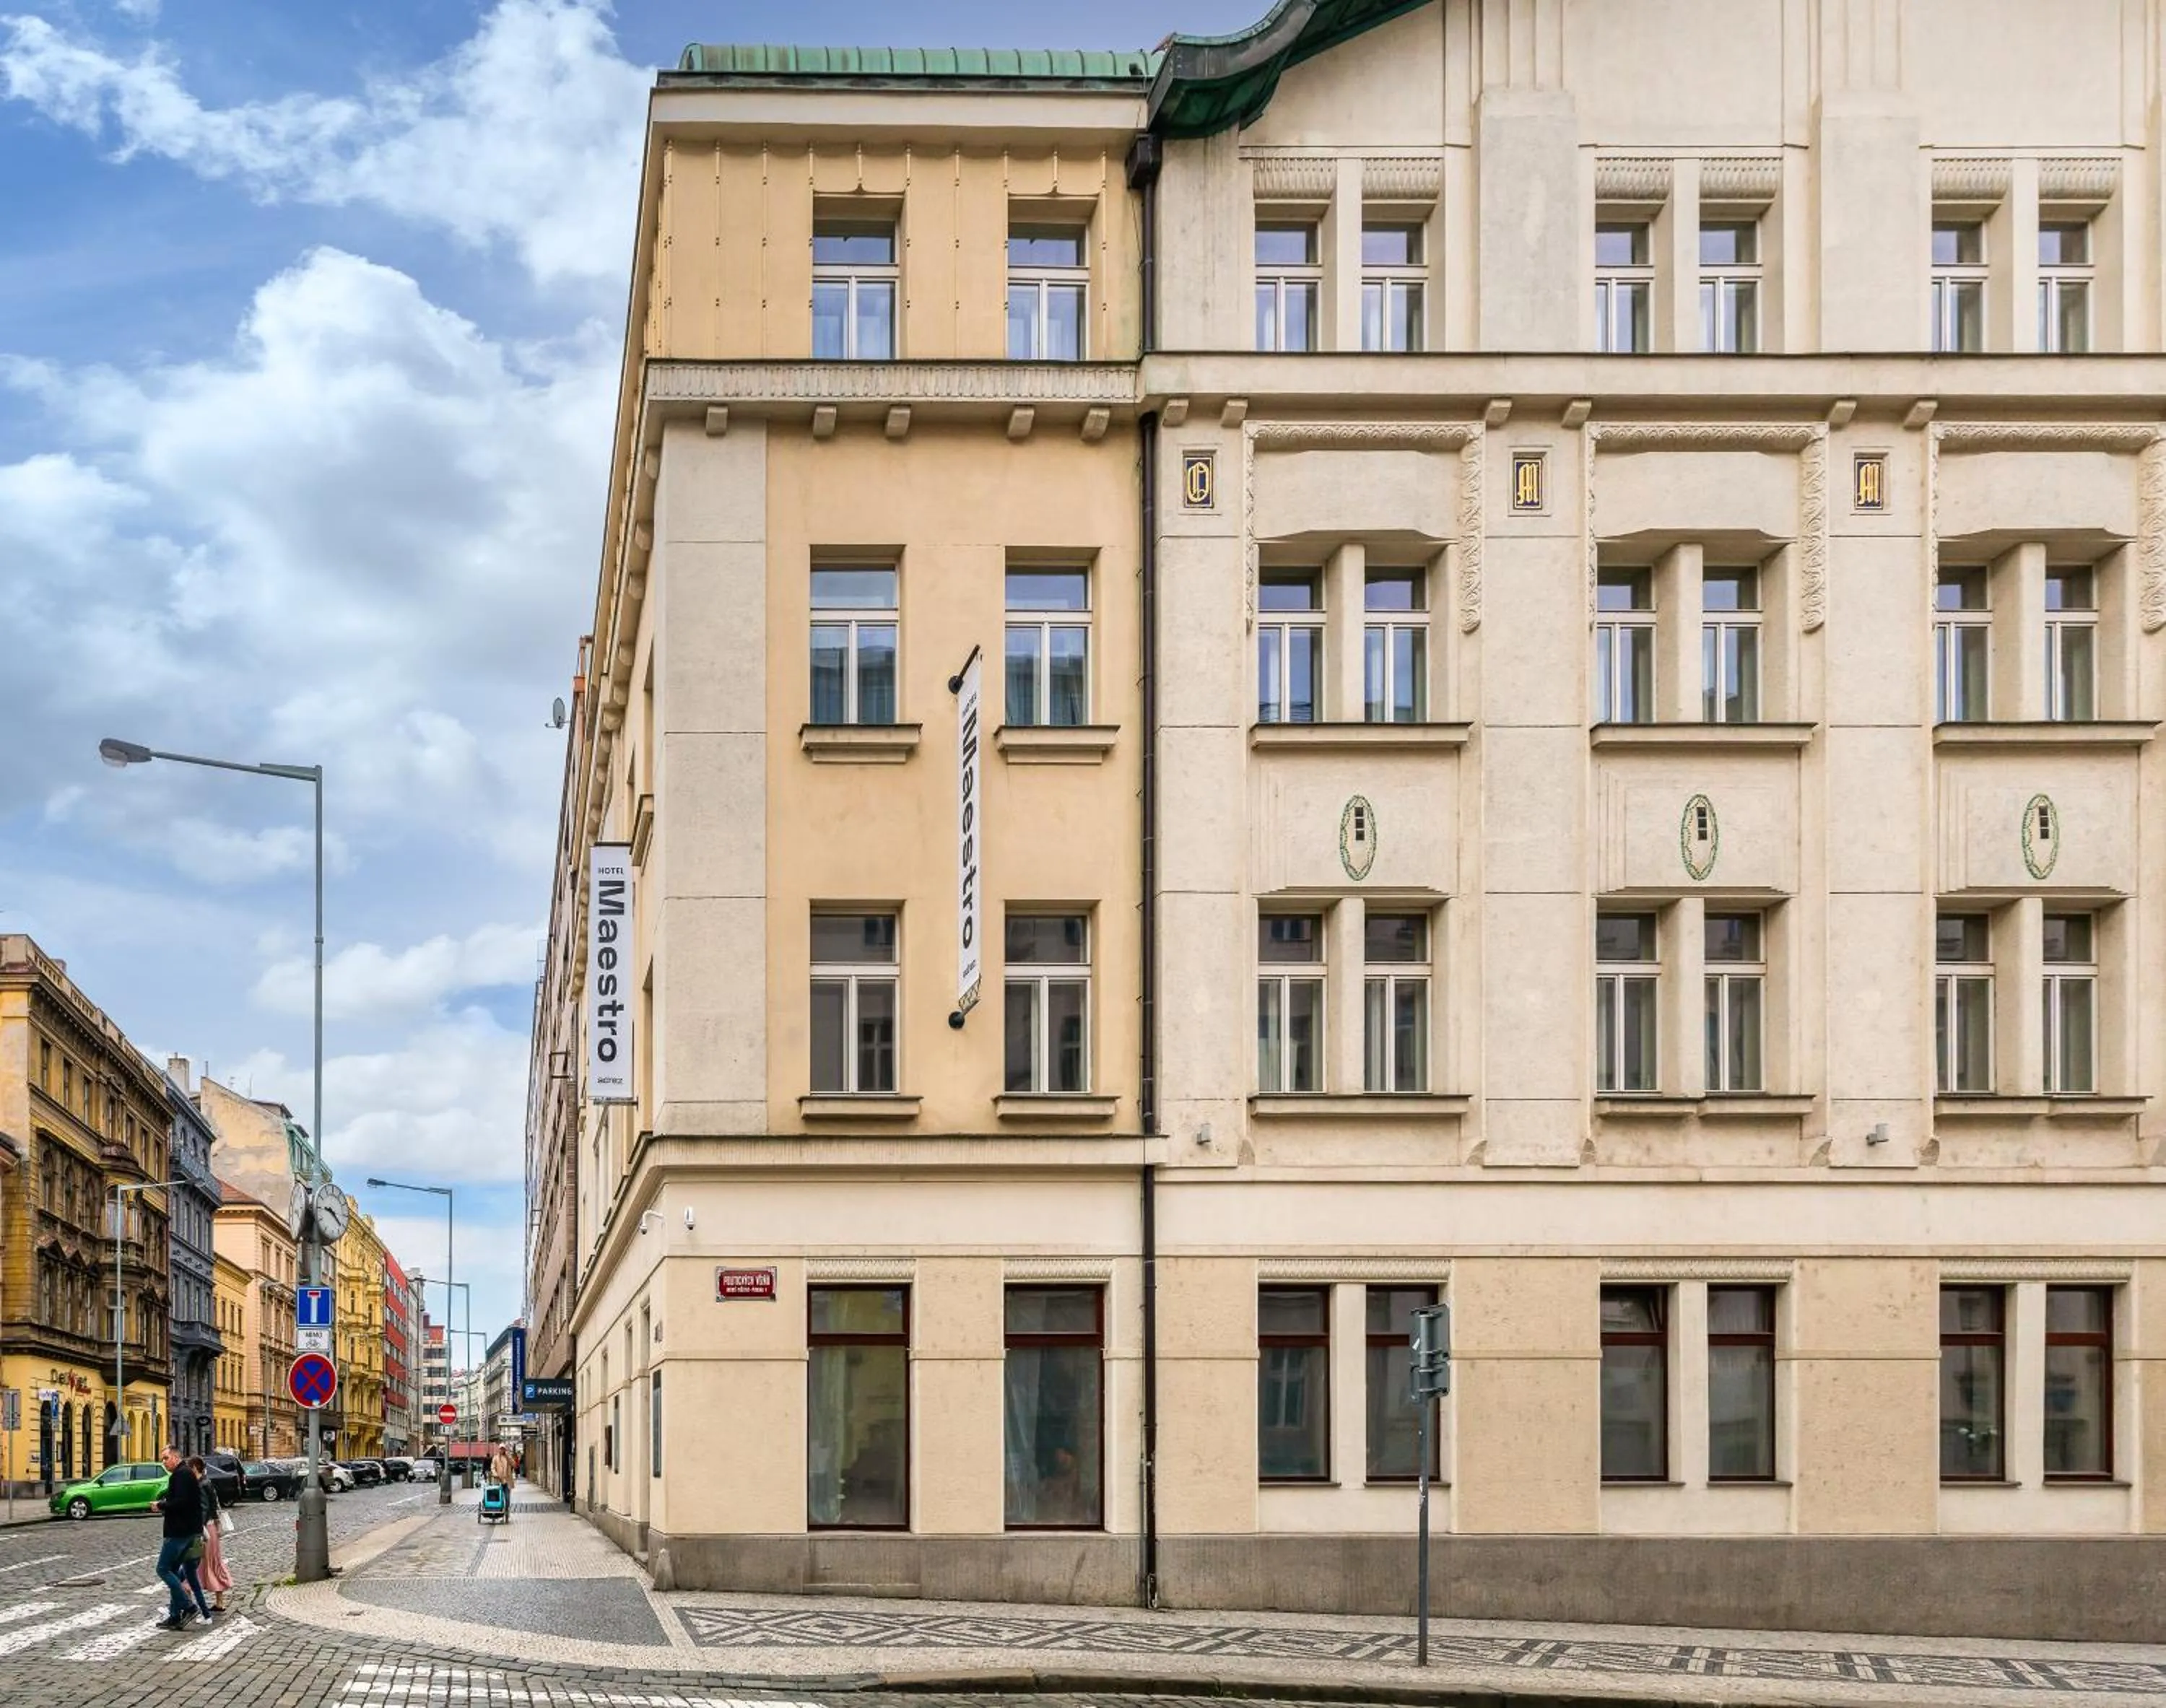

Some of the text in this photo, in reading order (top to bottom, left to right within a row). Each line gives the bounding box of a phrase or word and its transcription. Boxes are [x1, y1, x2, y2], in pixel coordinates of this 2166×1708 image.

[597, 866, 624, 875] HOTEL
[962, 707, 978, 949] Maestro
[597, 880, 625, 1063] Maestro
[537, 1387, 573, 1395] PARKING
